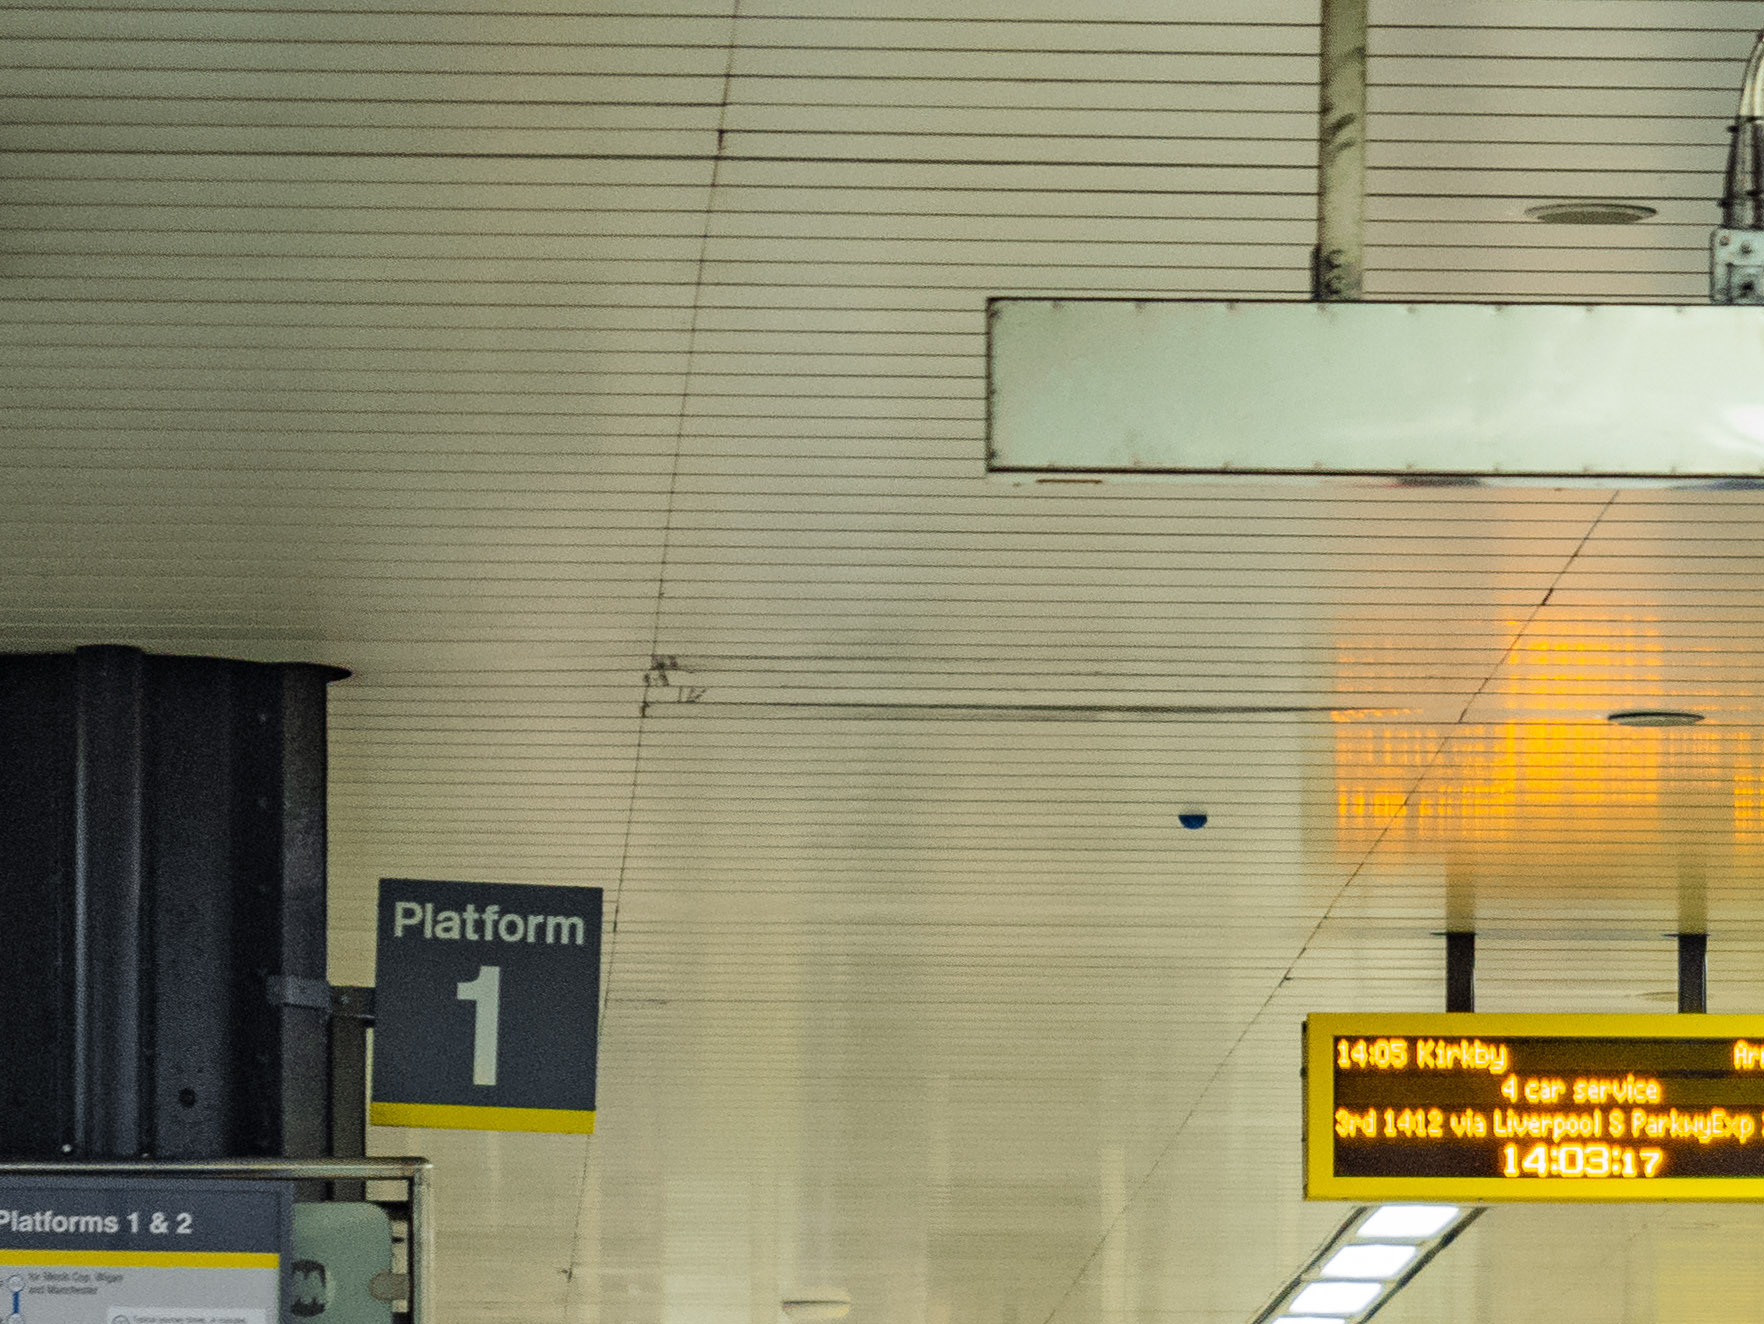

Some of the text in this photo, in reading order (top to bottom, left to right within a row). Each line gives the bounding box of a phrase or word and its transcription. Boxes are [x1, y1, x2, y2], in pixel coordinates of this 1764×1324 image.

[394, 901, 585, 945] Platform
[456, 965, 500, 1085] 1
[1337, 1038, 1408, 1069] 14:05
[1416, 1038, 1508, 1074] Kirkby
[1501, 1073, 1662, 1103] 4 car service
[1335, 1107, 1377, 1138] 3rd
[1384, 1107, 1443, 1138] 1412
[1449, 1107, 1488, 1138] via
[1493, 1107, 1603, 1143] Liverpool
[1608, 1107, 1625, 1138] S
[1503, 1143, 1663, 1178] 14:03:17
[127, 1211, 139, 1233] 1
[149, 1212, 169, 1234] &
[175, 1212, 194, 1235] 2
